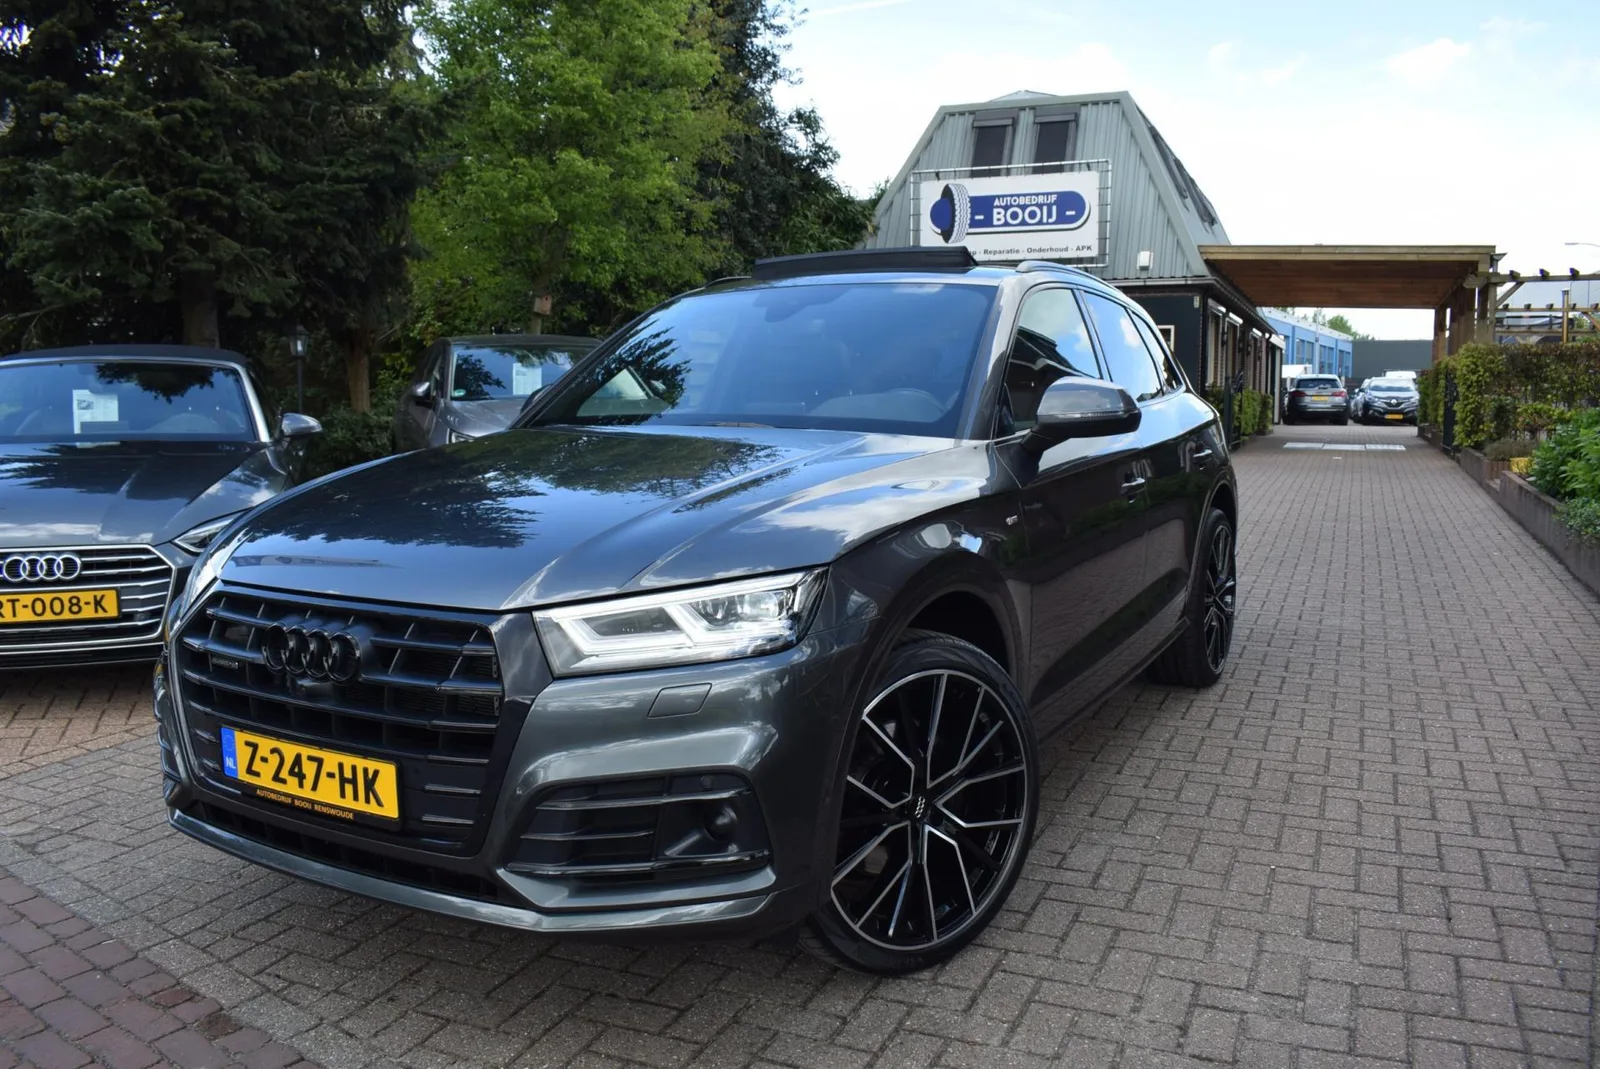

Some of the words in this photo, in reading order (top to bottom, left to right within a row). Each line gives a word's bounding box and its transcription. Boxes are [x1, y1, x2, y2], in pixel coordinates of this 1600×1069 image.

[993, 194, 1058, 206] AUTOBEDRIJF
[992, 205, 1057, 225] BOOIJ
[983, 248, 1020, 256] Reparatie
[1026, 246, 1069, 254] Onderhoud
[225, 756, 236, 770] NL
[244, 740, 385, 808] Z-247-HK
